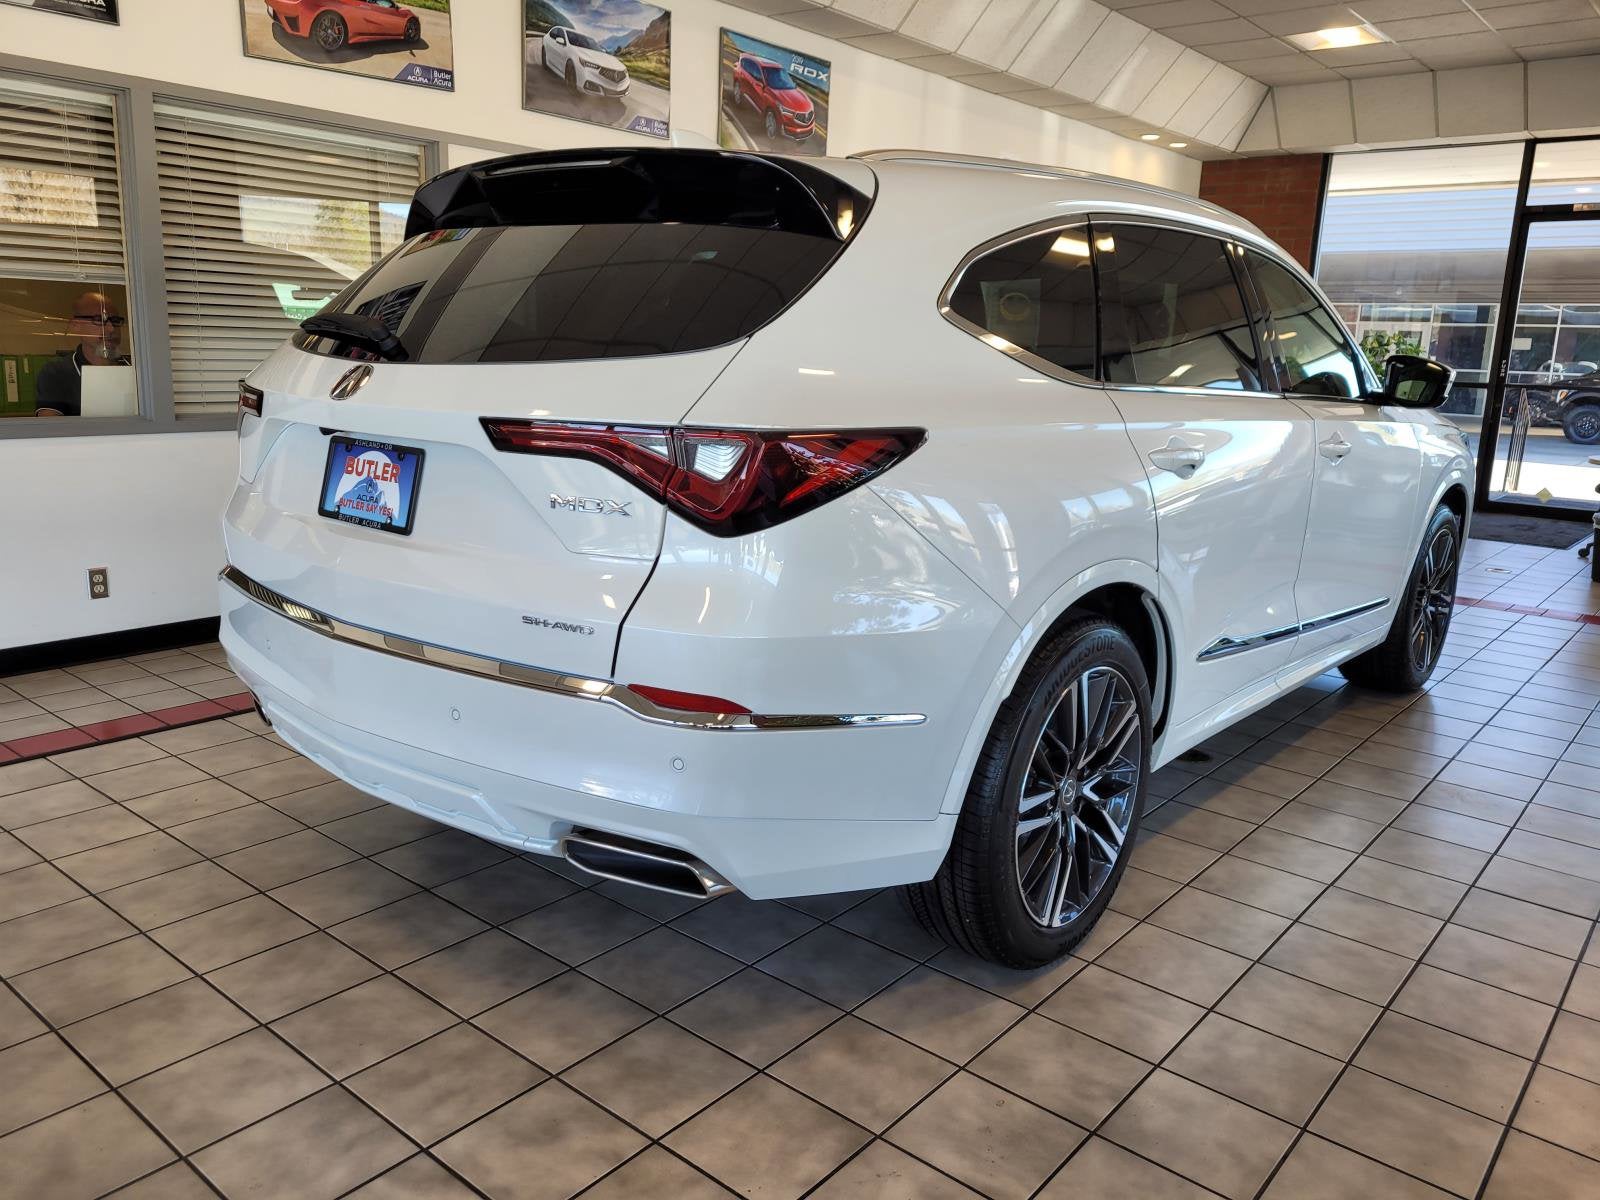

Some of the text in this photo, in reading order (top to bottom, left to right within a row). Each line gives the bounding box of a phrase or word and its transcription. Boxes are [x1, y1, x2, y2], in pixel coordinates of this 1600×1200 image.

[433, 70, 451, 80] Butler
[790, 63, 828, 81] RDX
[433, 78, 452, 87] Acura
[354, 440, 380, 449] ASHLAND
[345, 456, 401, 483] BUTLER
[339, 497, 365, 511] BUTLER
[366, 502, 378, 514] SAY
[356, 494, 379, 505] ACURA
[550, 493, 632, 516] MDX
[338, 514, 381, 529] BUTLER ACURA
